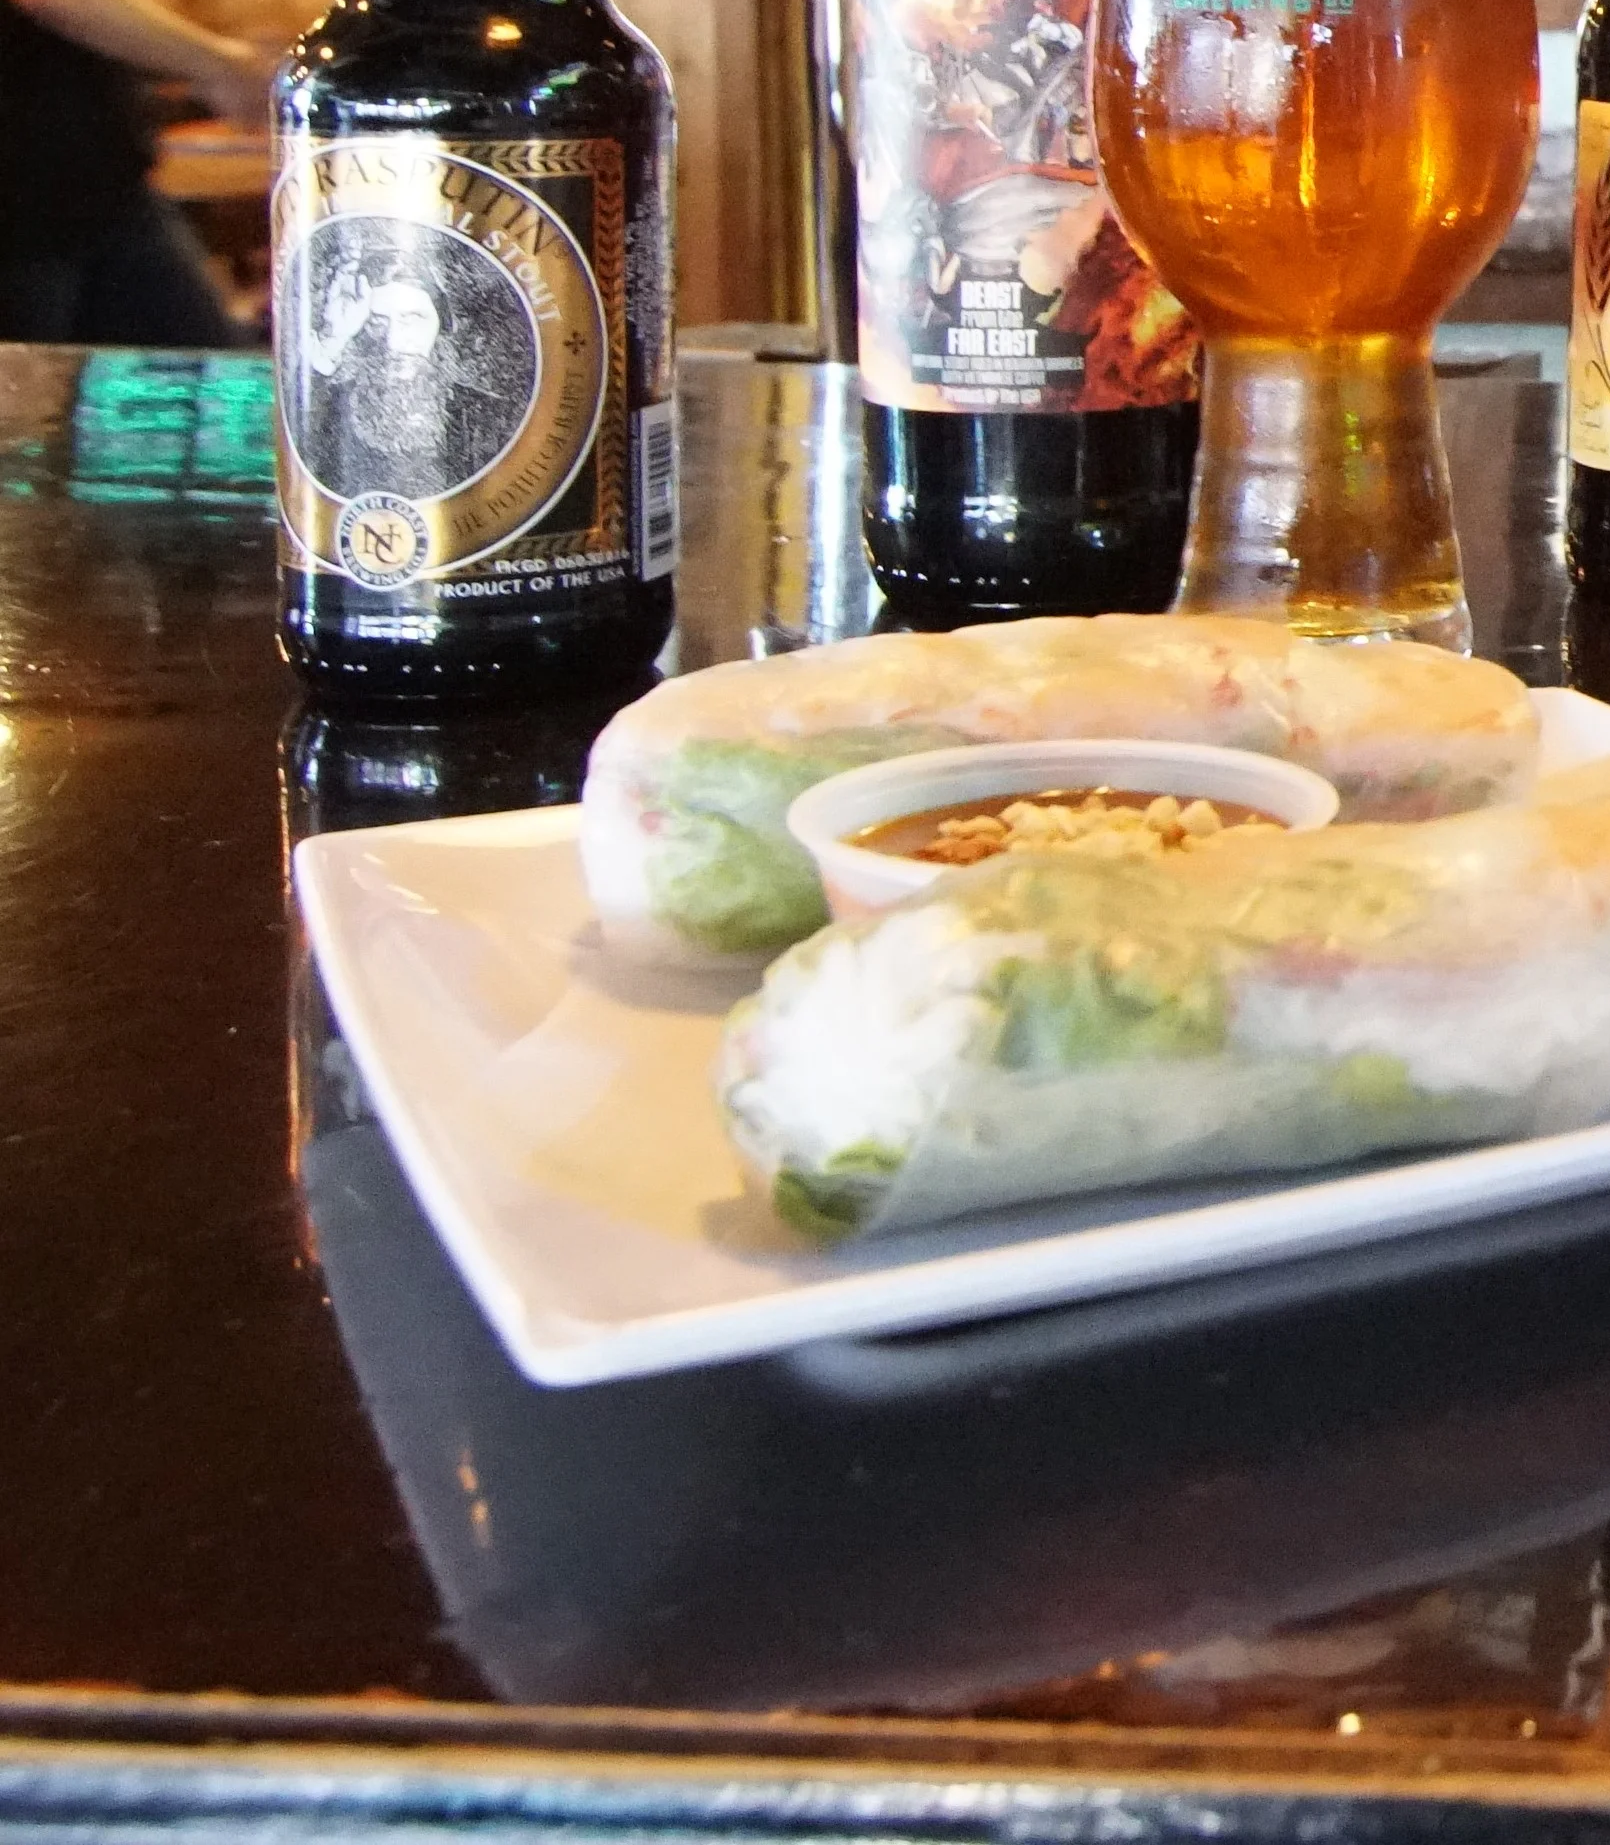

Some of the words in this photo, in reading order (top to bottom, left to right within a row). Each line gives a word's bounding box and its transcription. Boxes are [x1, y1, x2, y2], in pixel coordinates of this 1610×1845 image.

[482, 229, 561, 322] STOUT
[433, 579, 523, 599] PRODUCT
[529, 573, 555, 593] OF
[560, 569, 592, 589] THE
